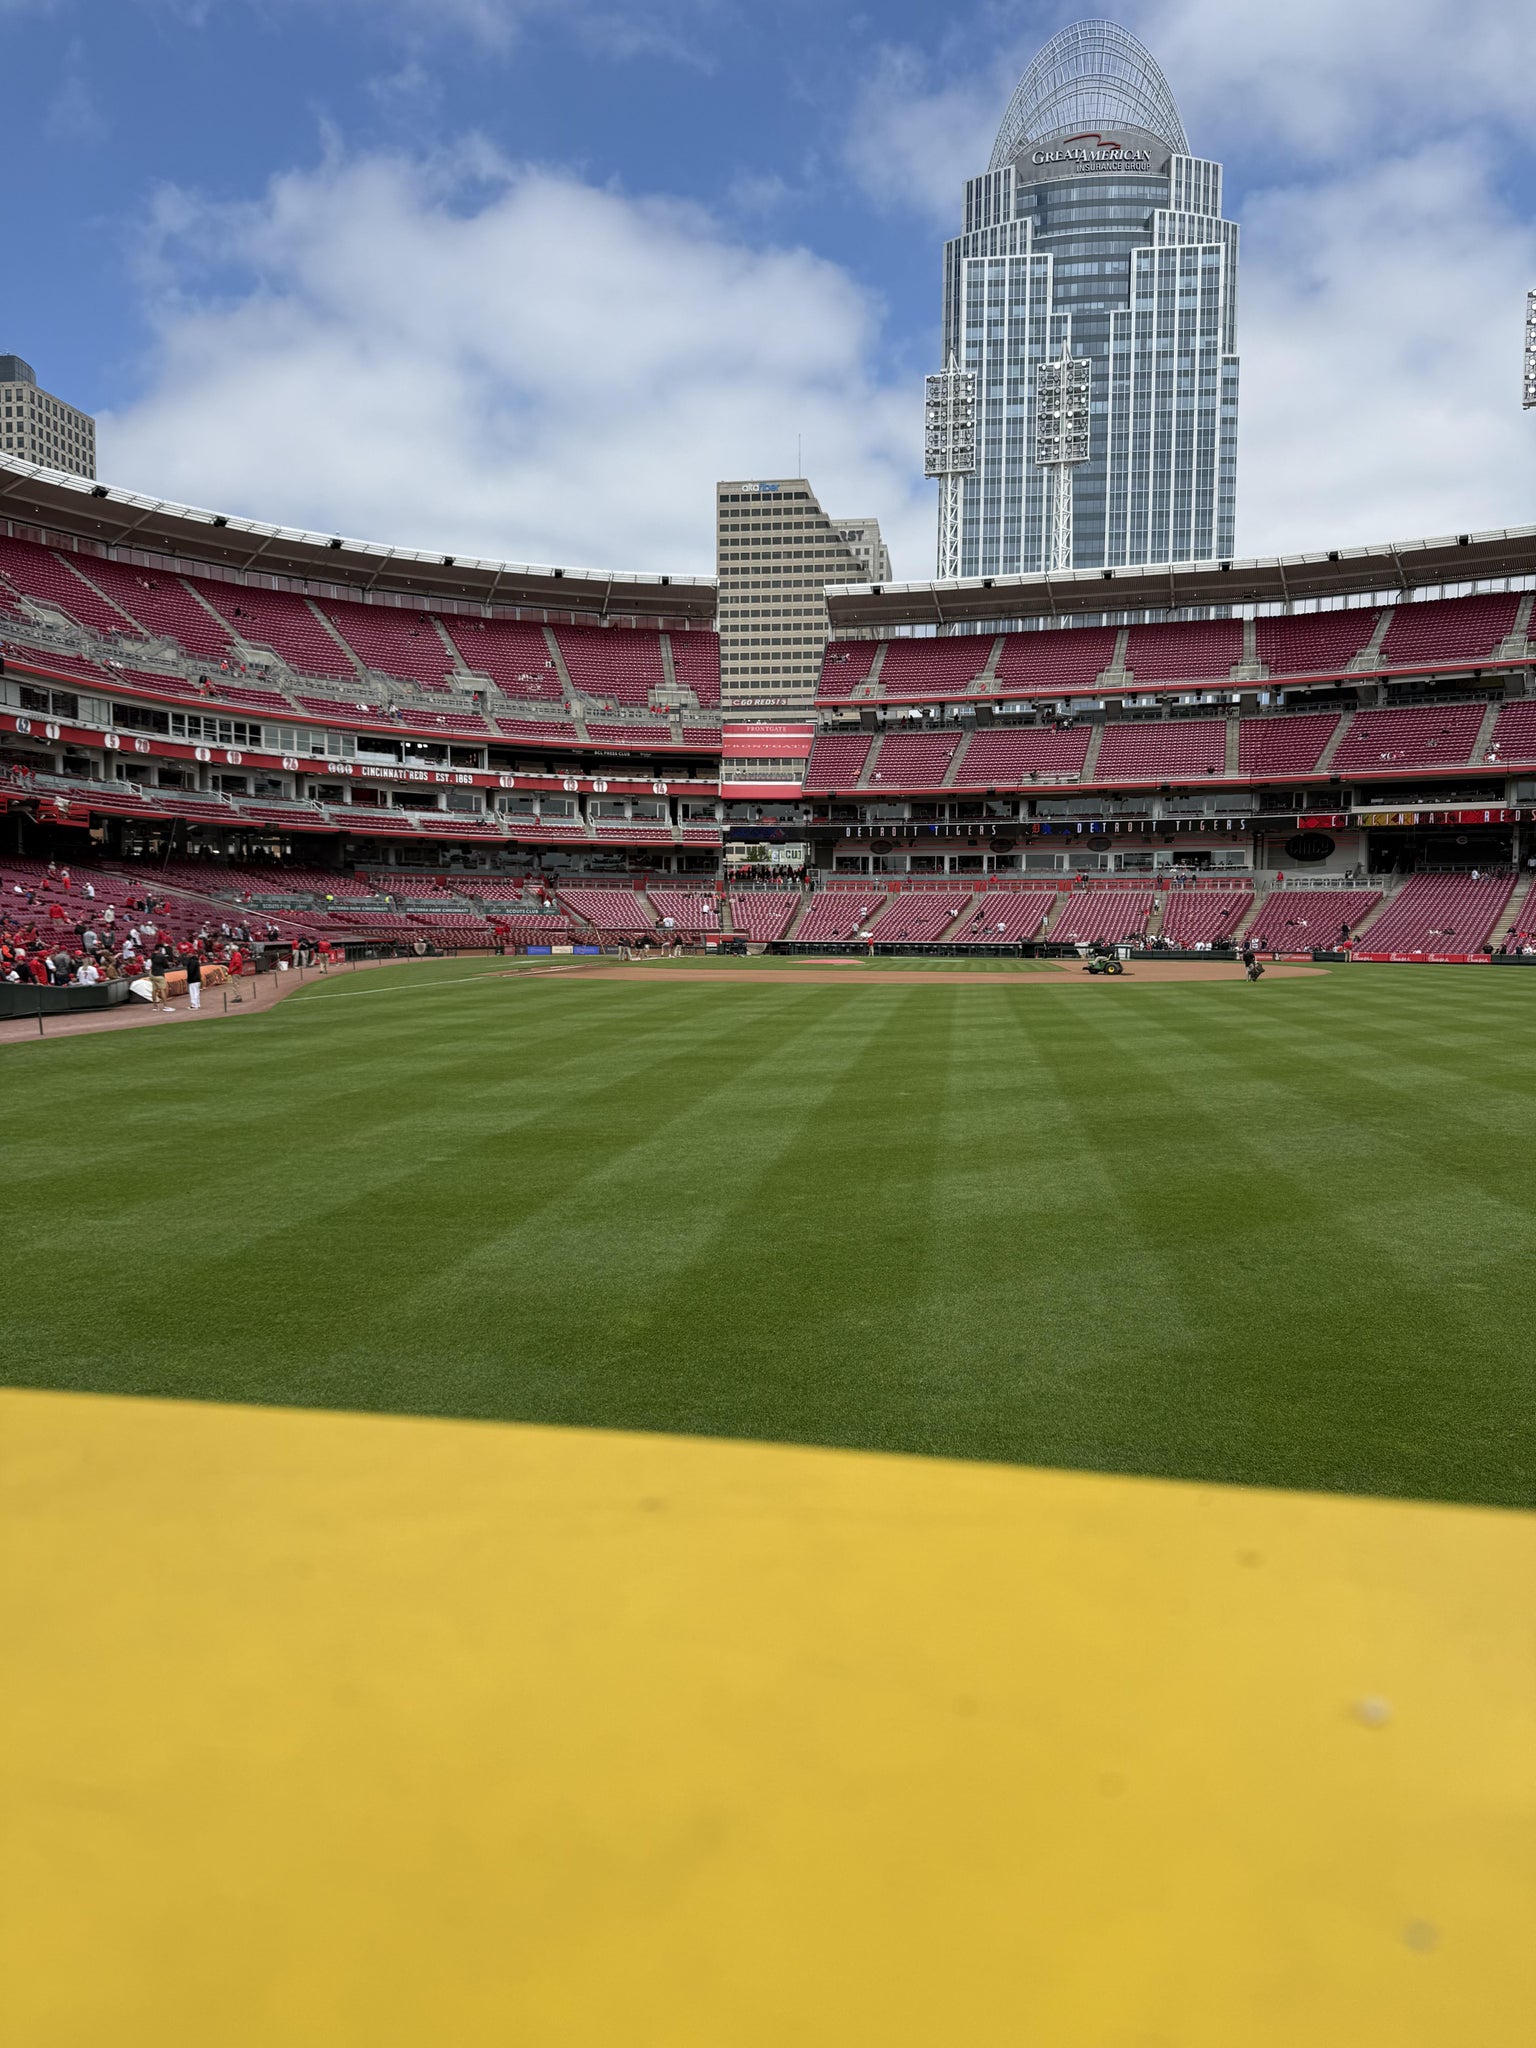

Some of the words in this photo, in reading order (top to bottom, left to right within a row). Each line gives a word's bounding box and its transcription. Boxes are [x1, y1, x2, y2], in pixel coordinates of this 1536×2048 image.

[1077, 162, 1122, 173] INSURANCE
[1125, 162, 1152, 171] GROUP
[362, 766, 406, 779] CINCINNATI
[409, 770, 429, 781] REDS
[435, 773, 453, 783] EST.
[455, 774, 473, 784] 1869
[1331, 811, 1462, 827] CINCINNATI
[1484, 810, 1536, 823] REDS
[845, 826, 918, 837] DETROIT
[934, 825, 997, 837] TIGERS
[1077, 821, 1157, 833] DETROIT
[1176, 819, 1245, 831] TIGERS
